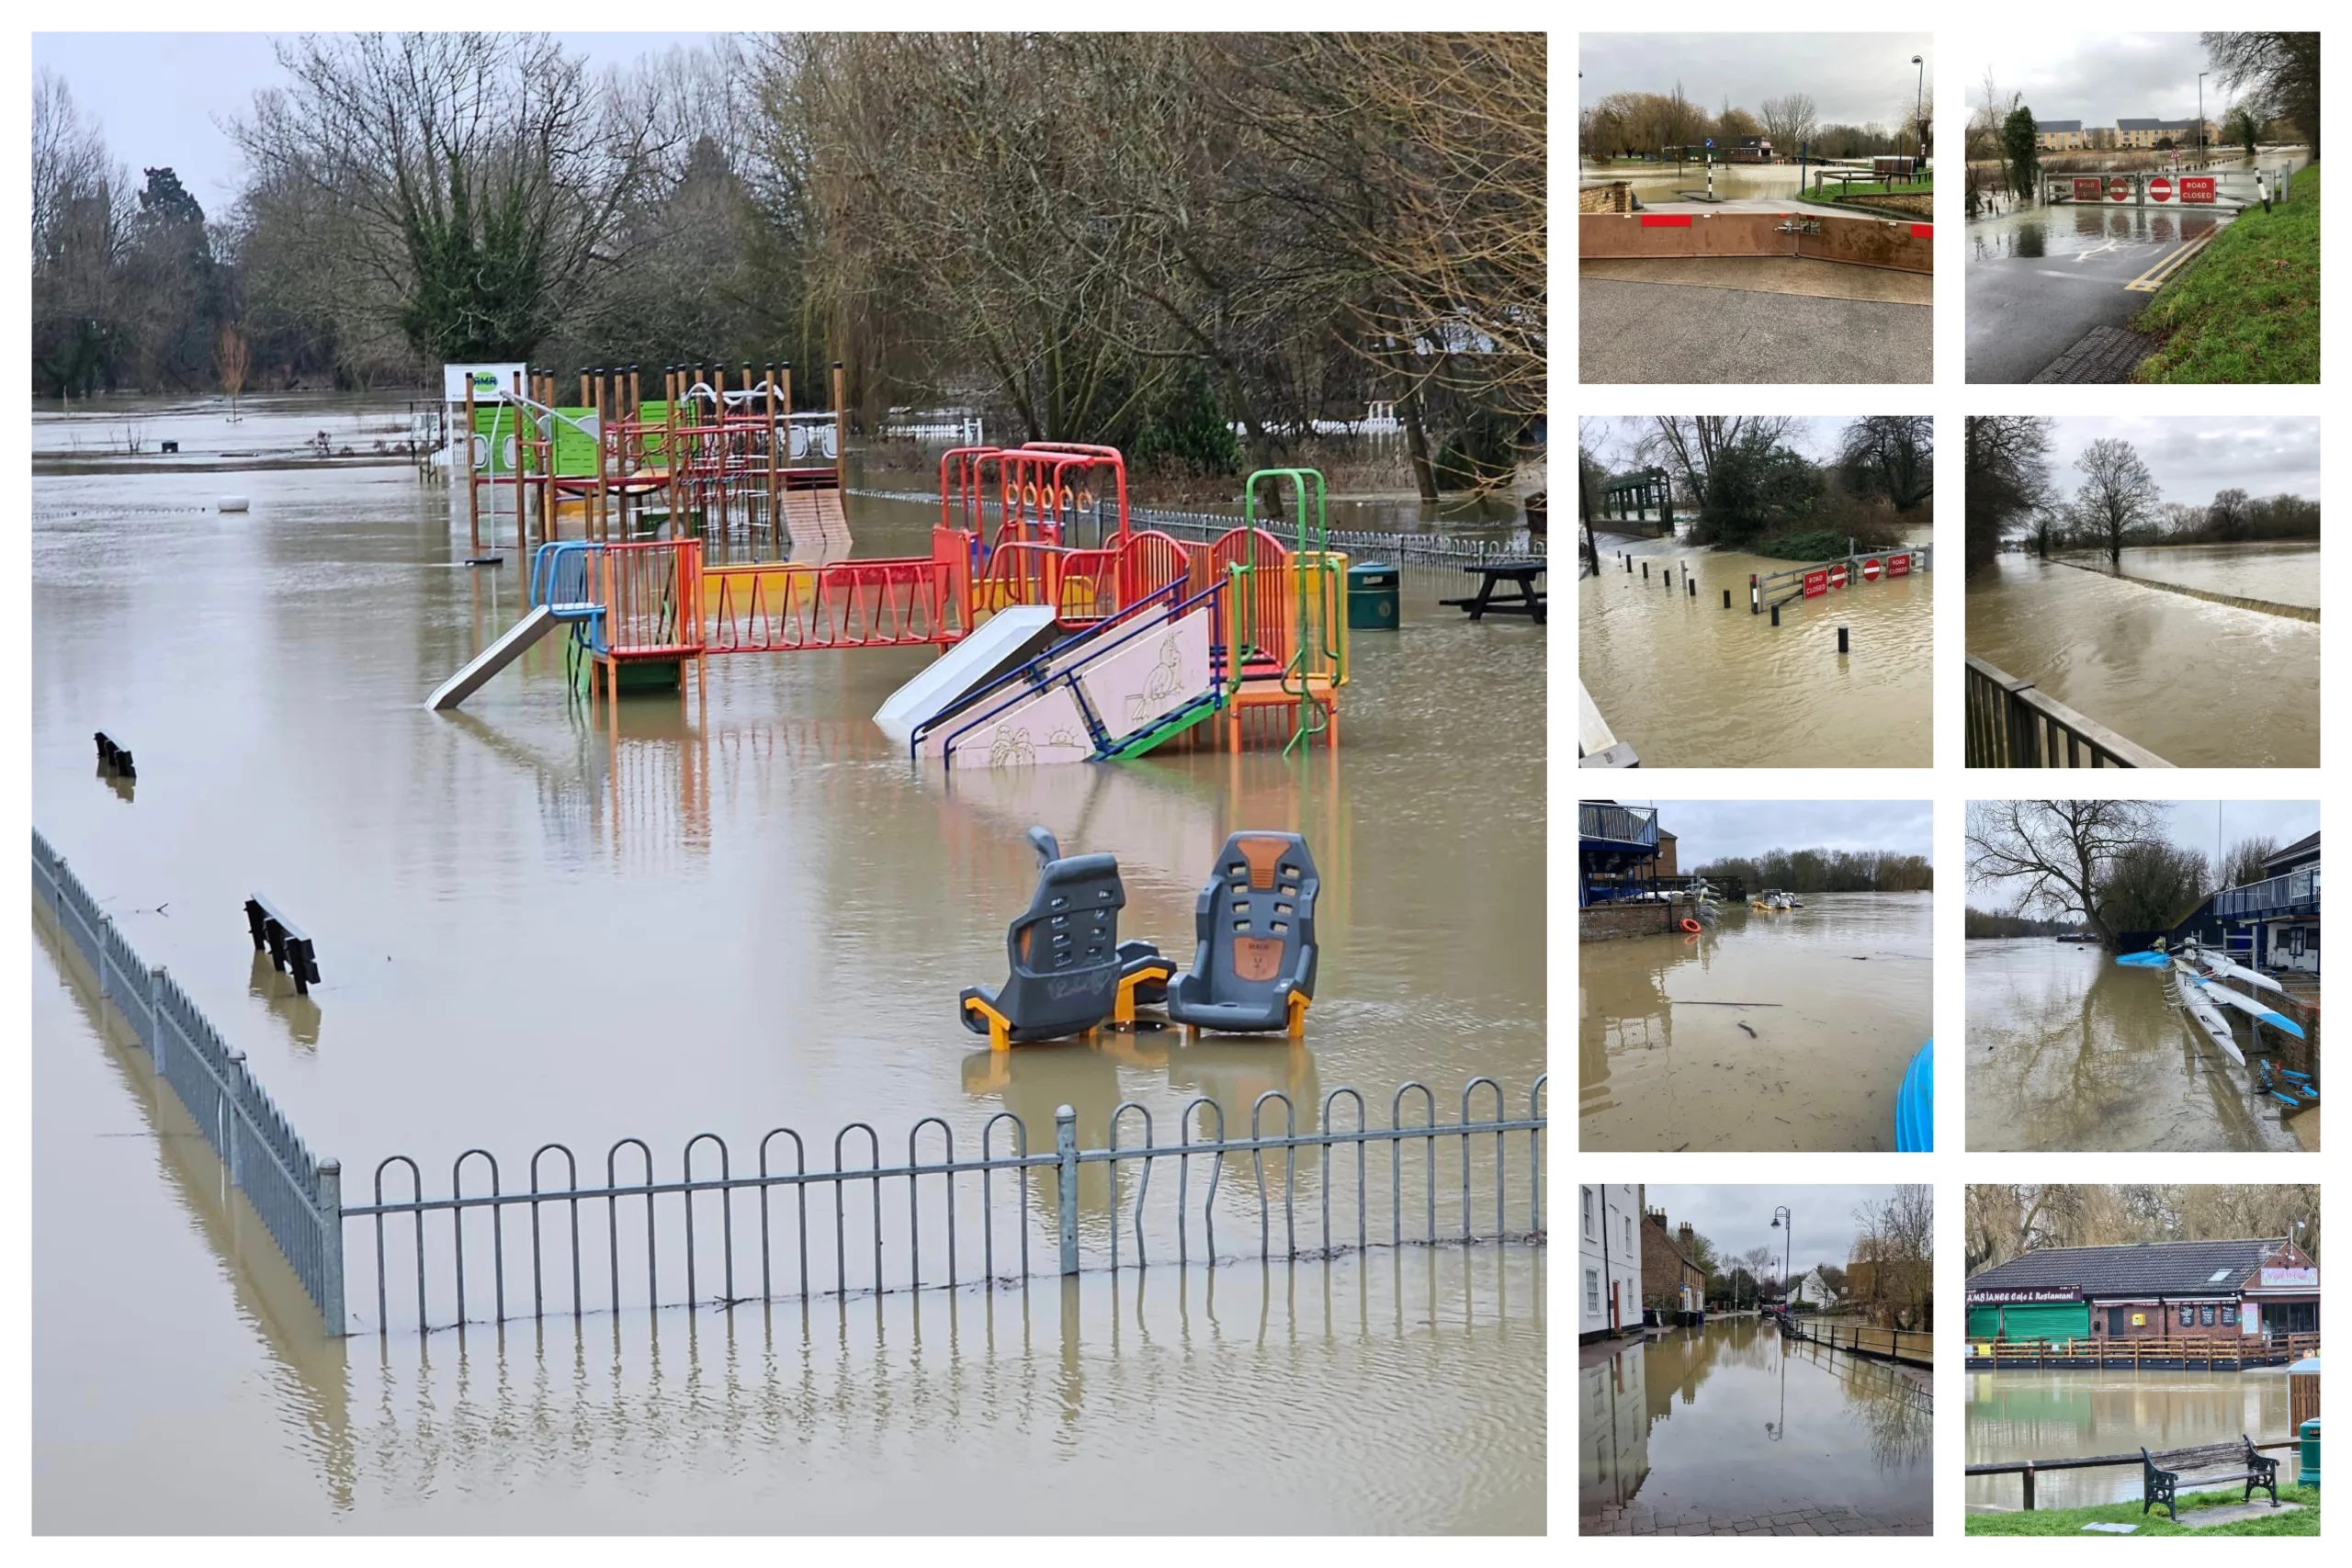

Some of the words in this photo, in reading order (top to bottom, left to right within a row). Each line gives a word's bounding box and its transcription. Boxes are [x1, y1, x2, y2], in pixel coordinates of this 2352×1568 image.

[1888, 567, 1908, 575] CLOSED
[1808, 575, 1823, 583] ROAD
[1805, 584, 1826, 595] CLOSED
[2028, 1292, 2033, 1301] &
[2035, 1291, 2074, 1301] Restaurant
